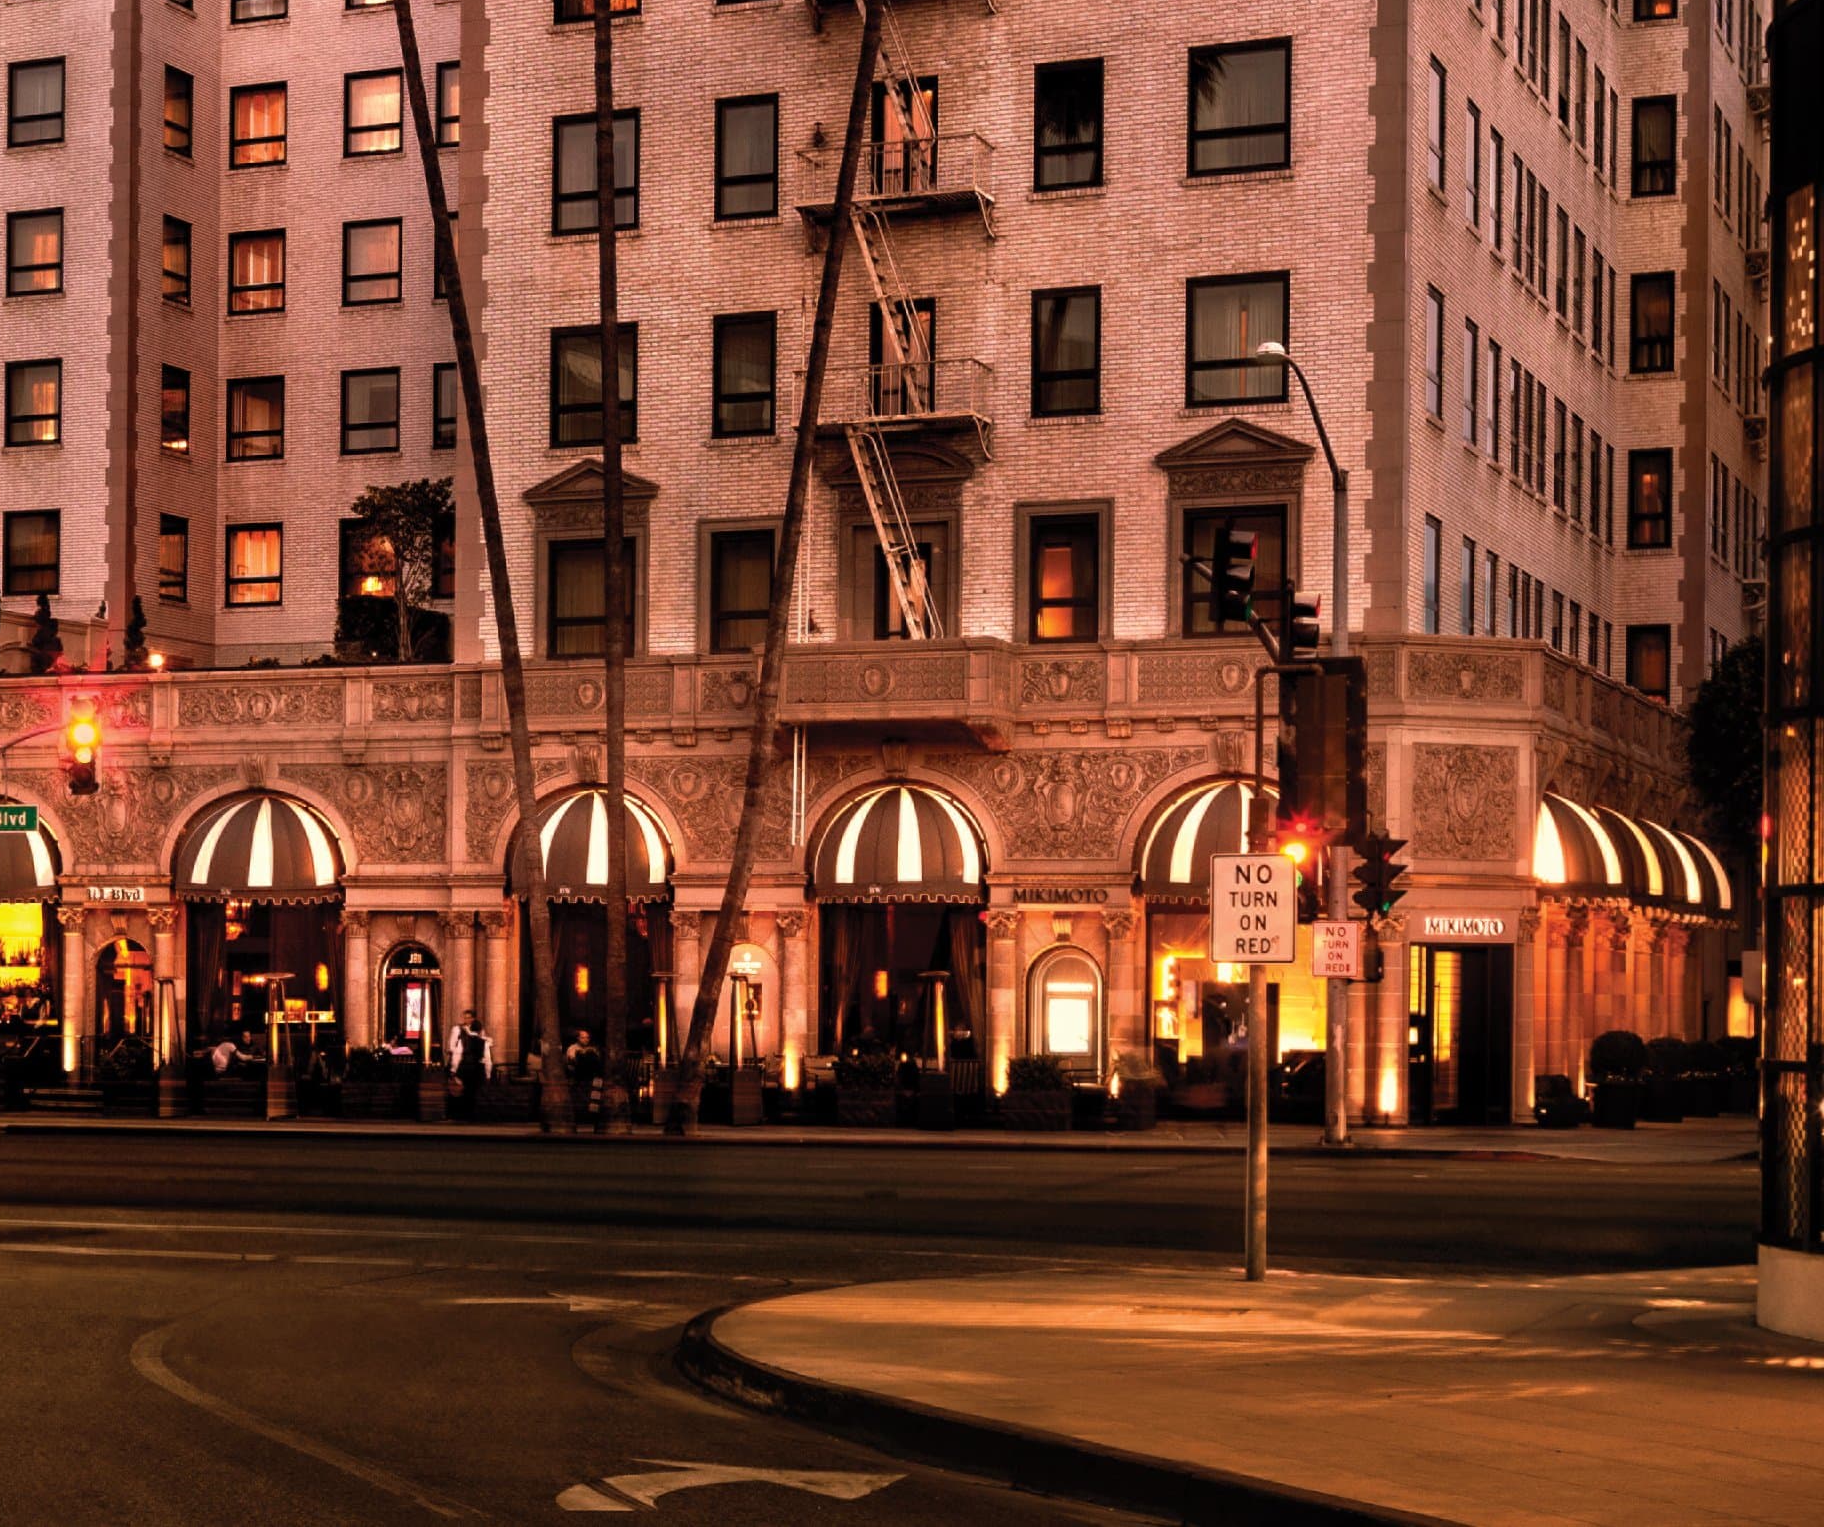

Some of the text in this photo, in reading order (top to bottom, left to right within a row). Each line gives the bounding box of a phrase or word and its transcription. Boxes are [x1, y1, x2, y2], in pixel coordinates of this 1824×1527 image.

[1235, 864, 1273, 884] NO
[1013, 888, 1108, 903] MIKIMOTO
[1229, 891, 1278, 907] TURN
[1240, 914, 1267, 930] ON
[1424, 916, 1505, 936] MIKIMOTO
[1326, 927, 1346, 937] NO
[1235, 938, 1271, 954] RED
[1323, 940, 1349, 949] TURN
[1328, 952, 1343, 961] ON
